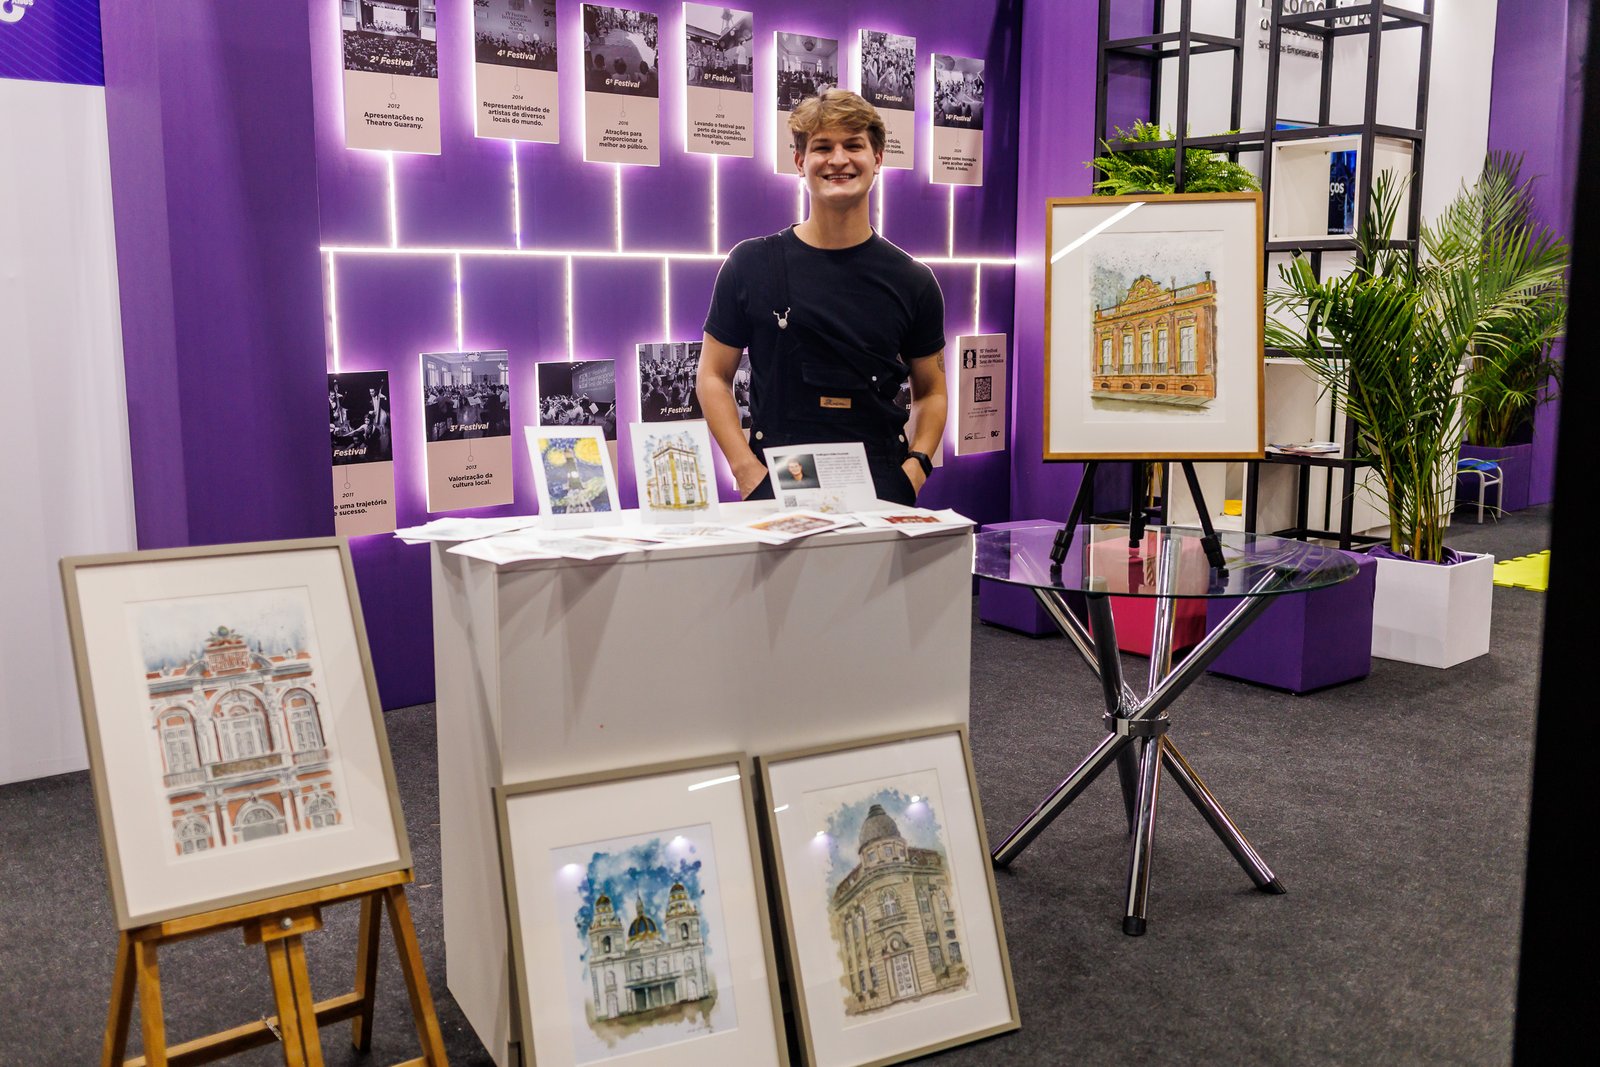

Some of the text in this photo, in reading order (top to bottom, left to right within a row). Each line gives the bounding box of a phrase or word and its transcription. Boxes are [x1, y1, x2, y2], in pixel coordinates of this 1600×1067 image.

[507, 51, 536, 60] Festival
[380, 57, 414, 67] Festival
[712, 74, 736, 83] Festival
[614, 80, 640, 88] Festival
[483, 102, 541, 112] Representatividade
[364, 112, 414, 121] Apresentações
[394, 121, 423, 130] Guarany.
[1330, 182, 1344, 196] ços
[668, 405, 692, 414] Festival
[459, 422, 489, 431] Festival
[333, 447, 366, 457] Festival
[448, 474, 484, 482] Valorização
[356, 499, 387, 507] trajetória
